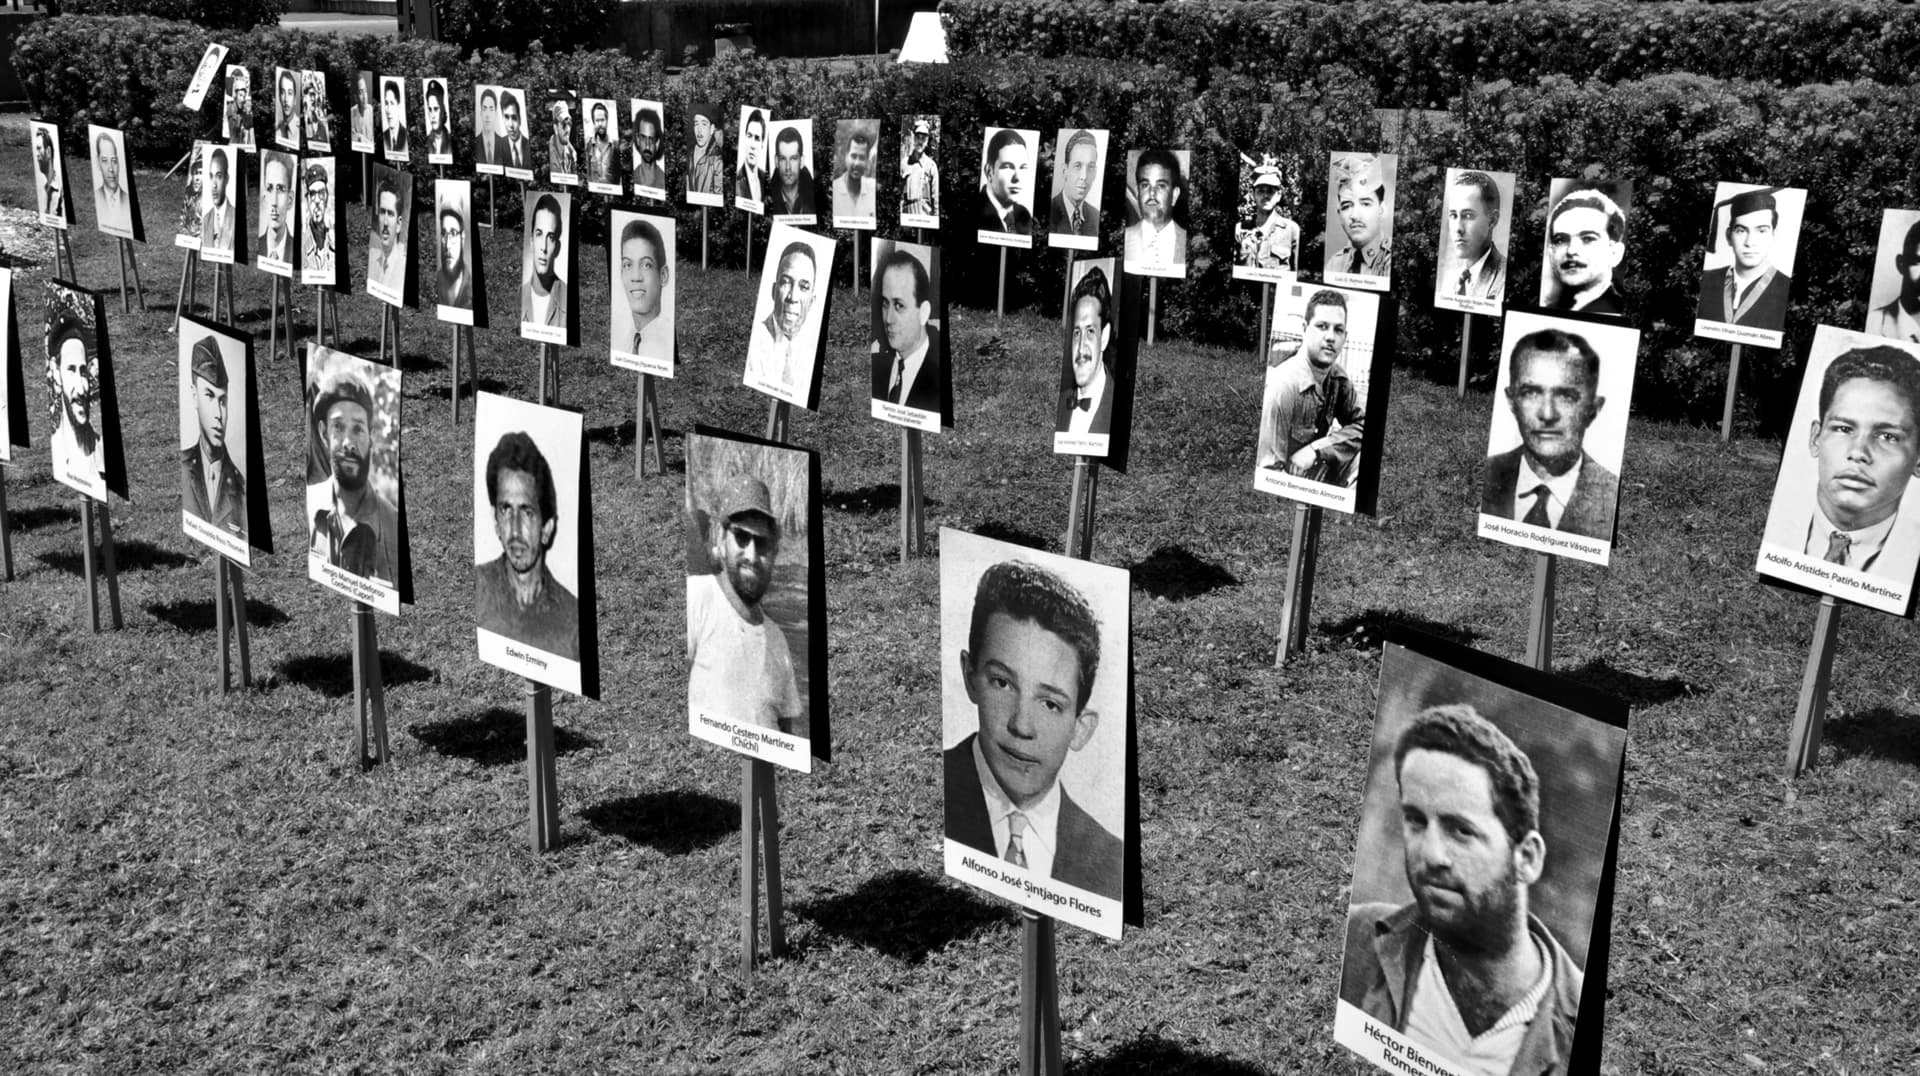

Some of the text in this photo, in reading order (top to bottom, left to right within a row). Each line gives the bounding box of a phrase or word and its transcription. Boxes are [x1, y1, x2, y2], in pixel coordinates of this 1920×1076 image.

[1483, 521, 1500, 531] José
[1500, 525, 1529, 539] Horacio
[1765, 552, 1793, 567] Adolfo
[1831, 572, 1860, 588] Patiño
[506, 646, 525, 660] Edwin
[700, 713, 732, 733] Fernando
[732, 724, 760, 741] Cestero
[961, 856, 998, 879] Alfonso
[999, 871, 1022, 889] José
[1069, 897, 1102, 918] Flores
[1364, 1021, 1461, 1076] Héctor Bienve
[1383, 1048, 1428, 1076] Rome
